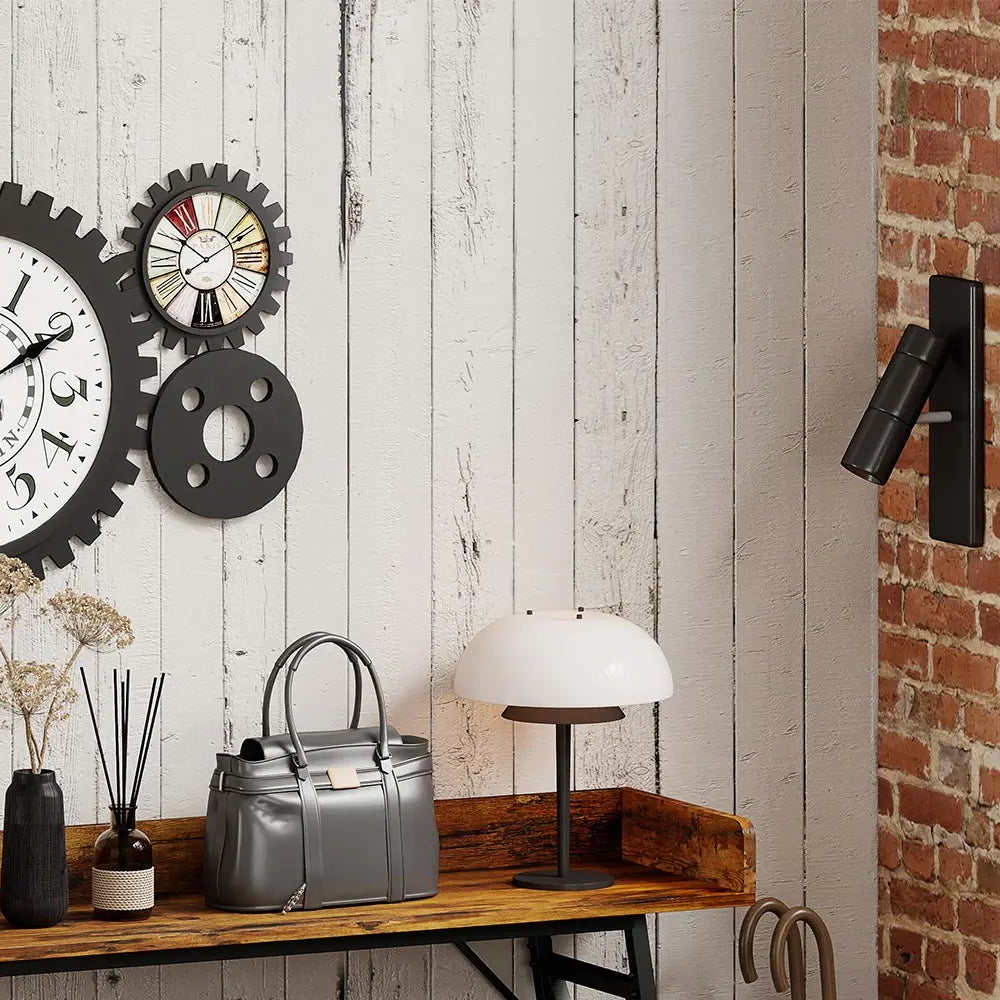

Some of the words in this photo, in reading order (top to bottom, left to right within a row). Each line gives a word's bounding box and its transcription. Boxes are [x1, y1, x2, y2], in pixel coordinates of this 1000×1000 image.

[173, 203, 198, 234] XI
[236, 251, 263, 264] III
[1, 269, 32, 317] 1
[34, 311, 75, 352] 2
[49, 370, 89, 408] 3
[40, 428, 79, 470] 4
[6, 463, 36, 511] 5
